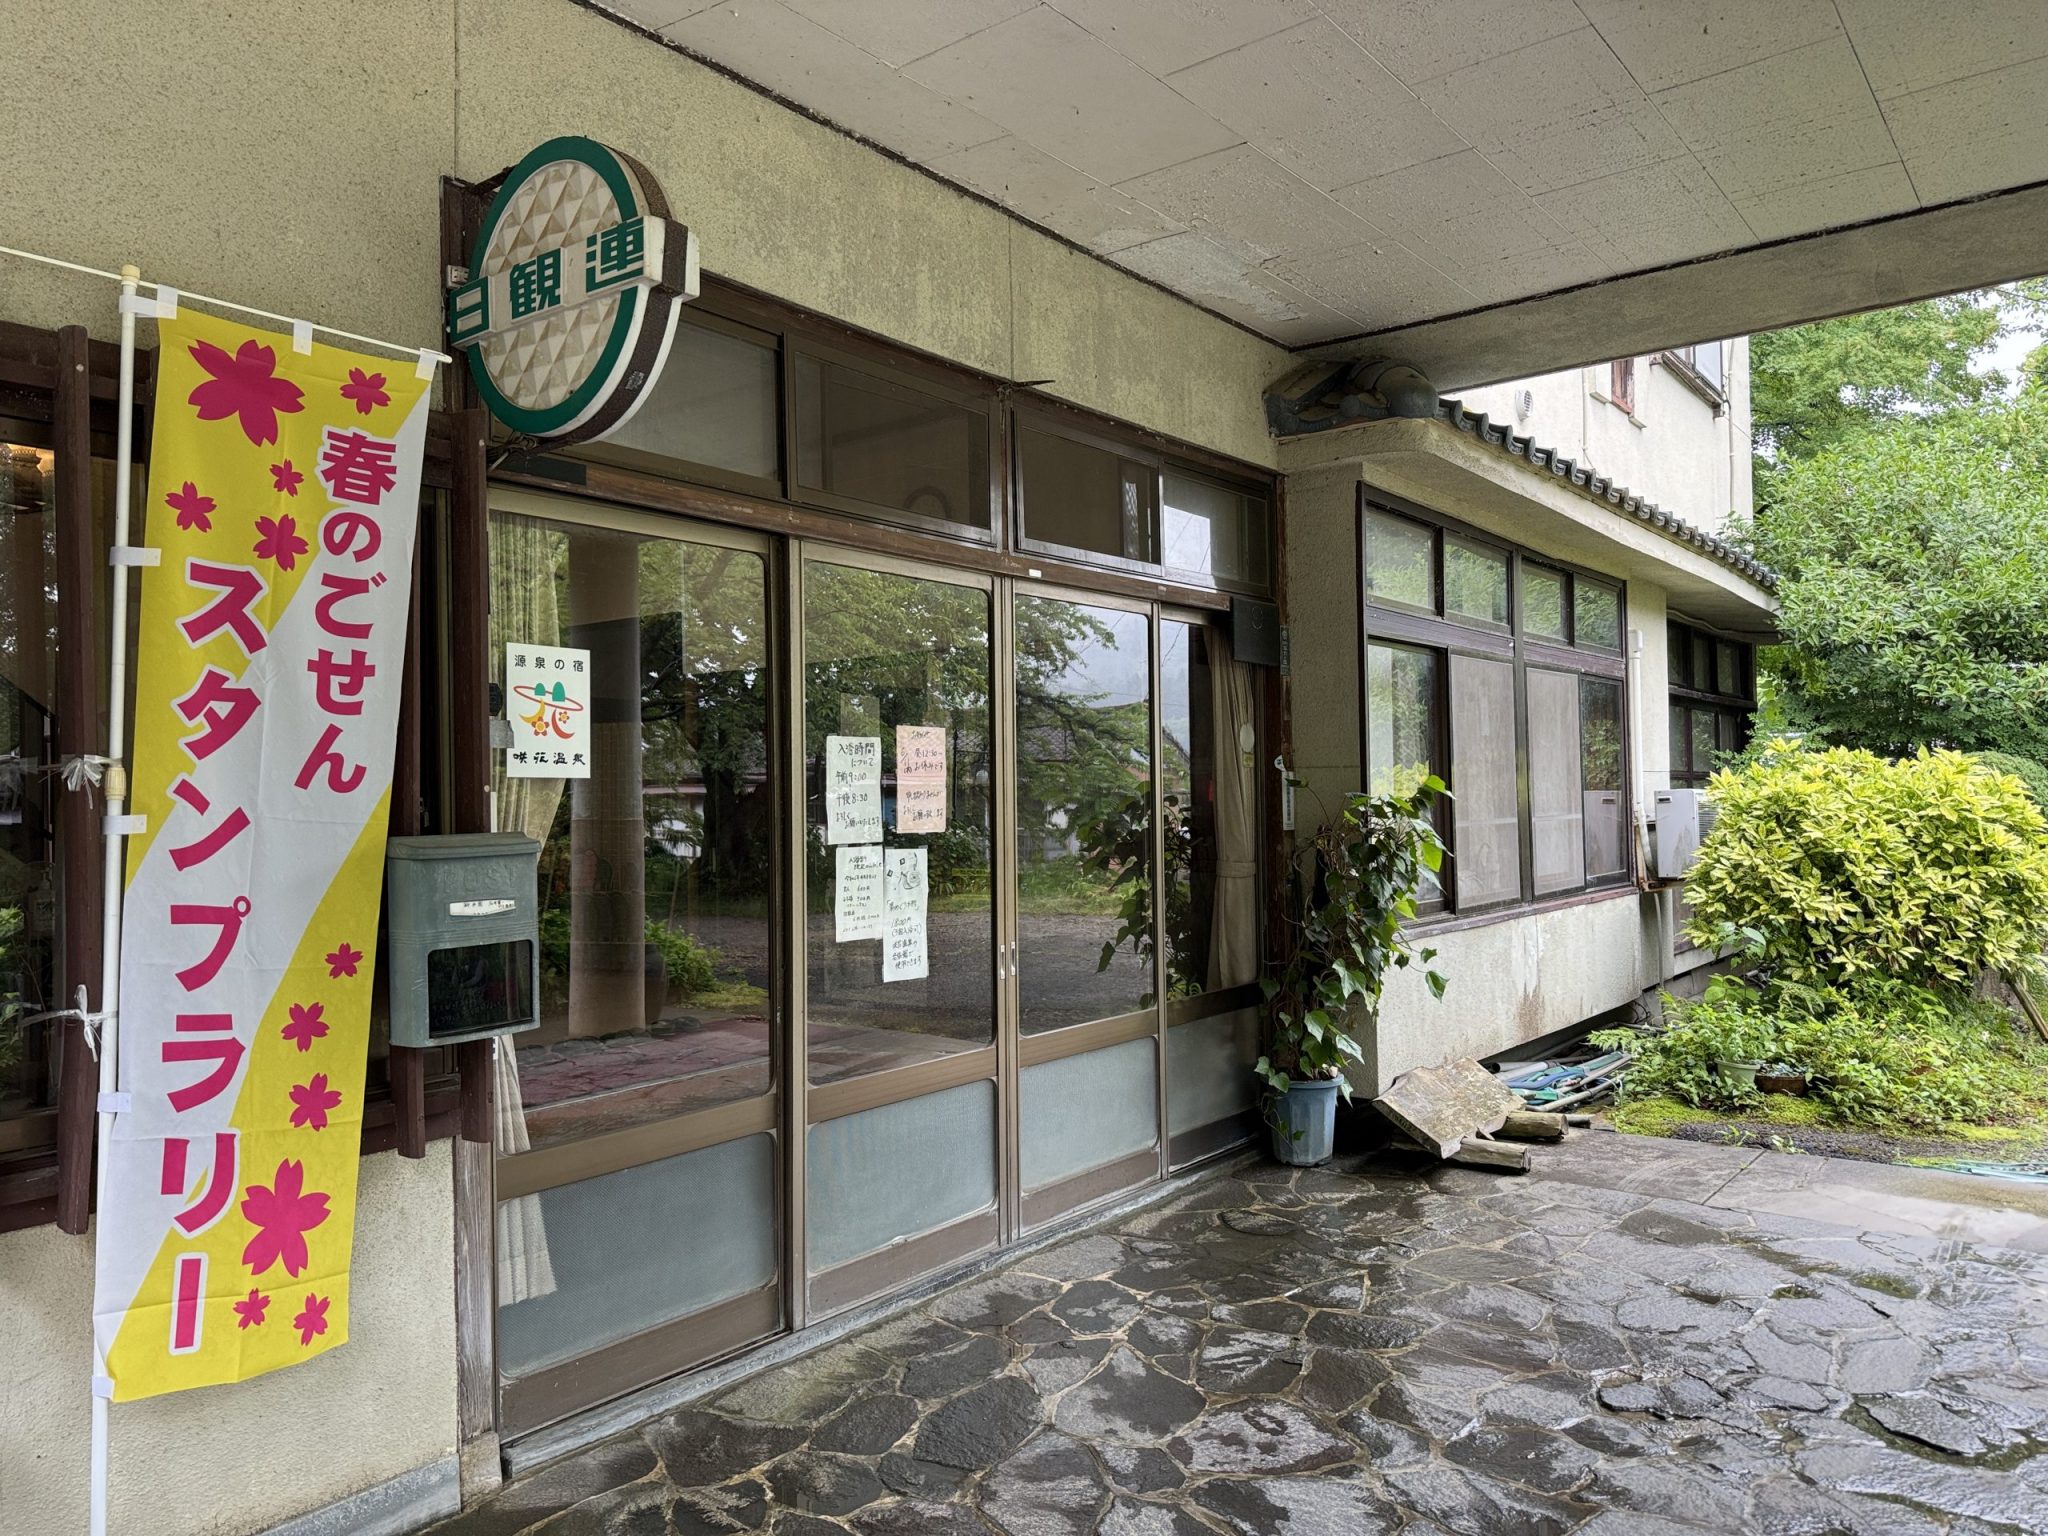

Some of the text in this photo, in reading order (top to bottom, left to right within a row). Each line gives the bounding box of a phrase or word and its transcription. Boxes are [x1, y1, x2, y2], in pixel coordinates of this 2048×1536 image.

[449, 216, 644, 344] 日観連
[293, 429, 398, 794] 春のごせん
[514, 654, 583, 672] 源泉の宿
[838, 742, 875, 756] 入浴時間
[512, 751, 586, 766] 咲花温泉
[851, 758, 875, 768] について
[160, 560, 268, 1349] スタンプラリー
